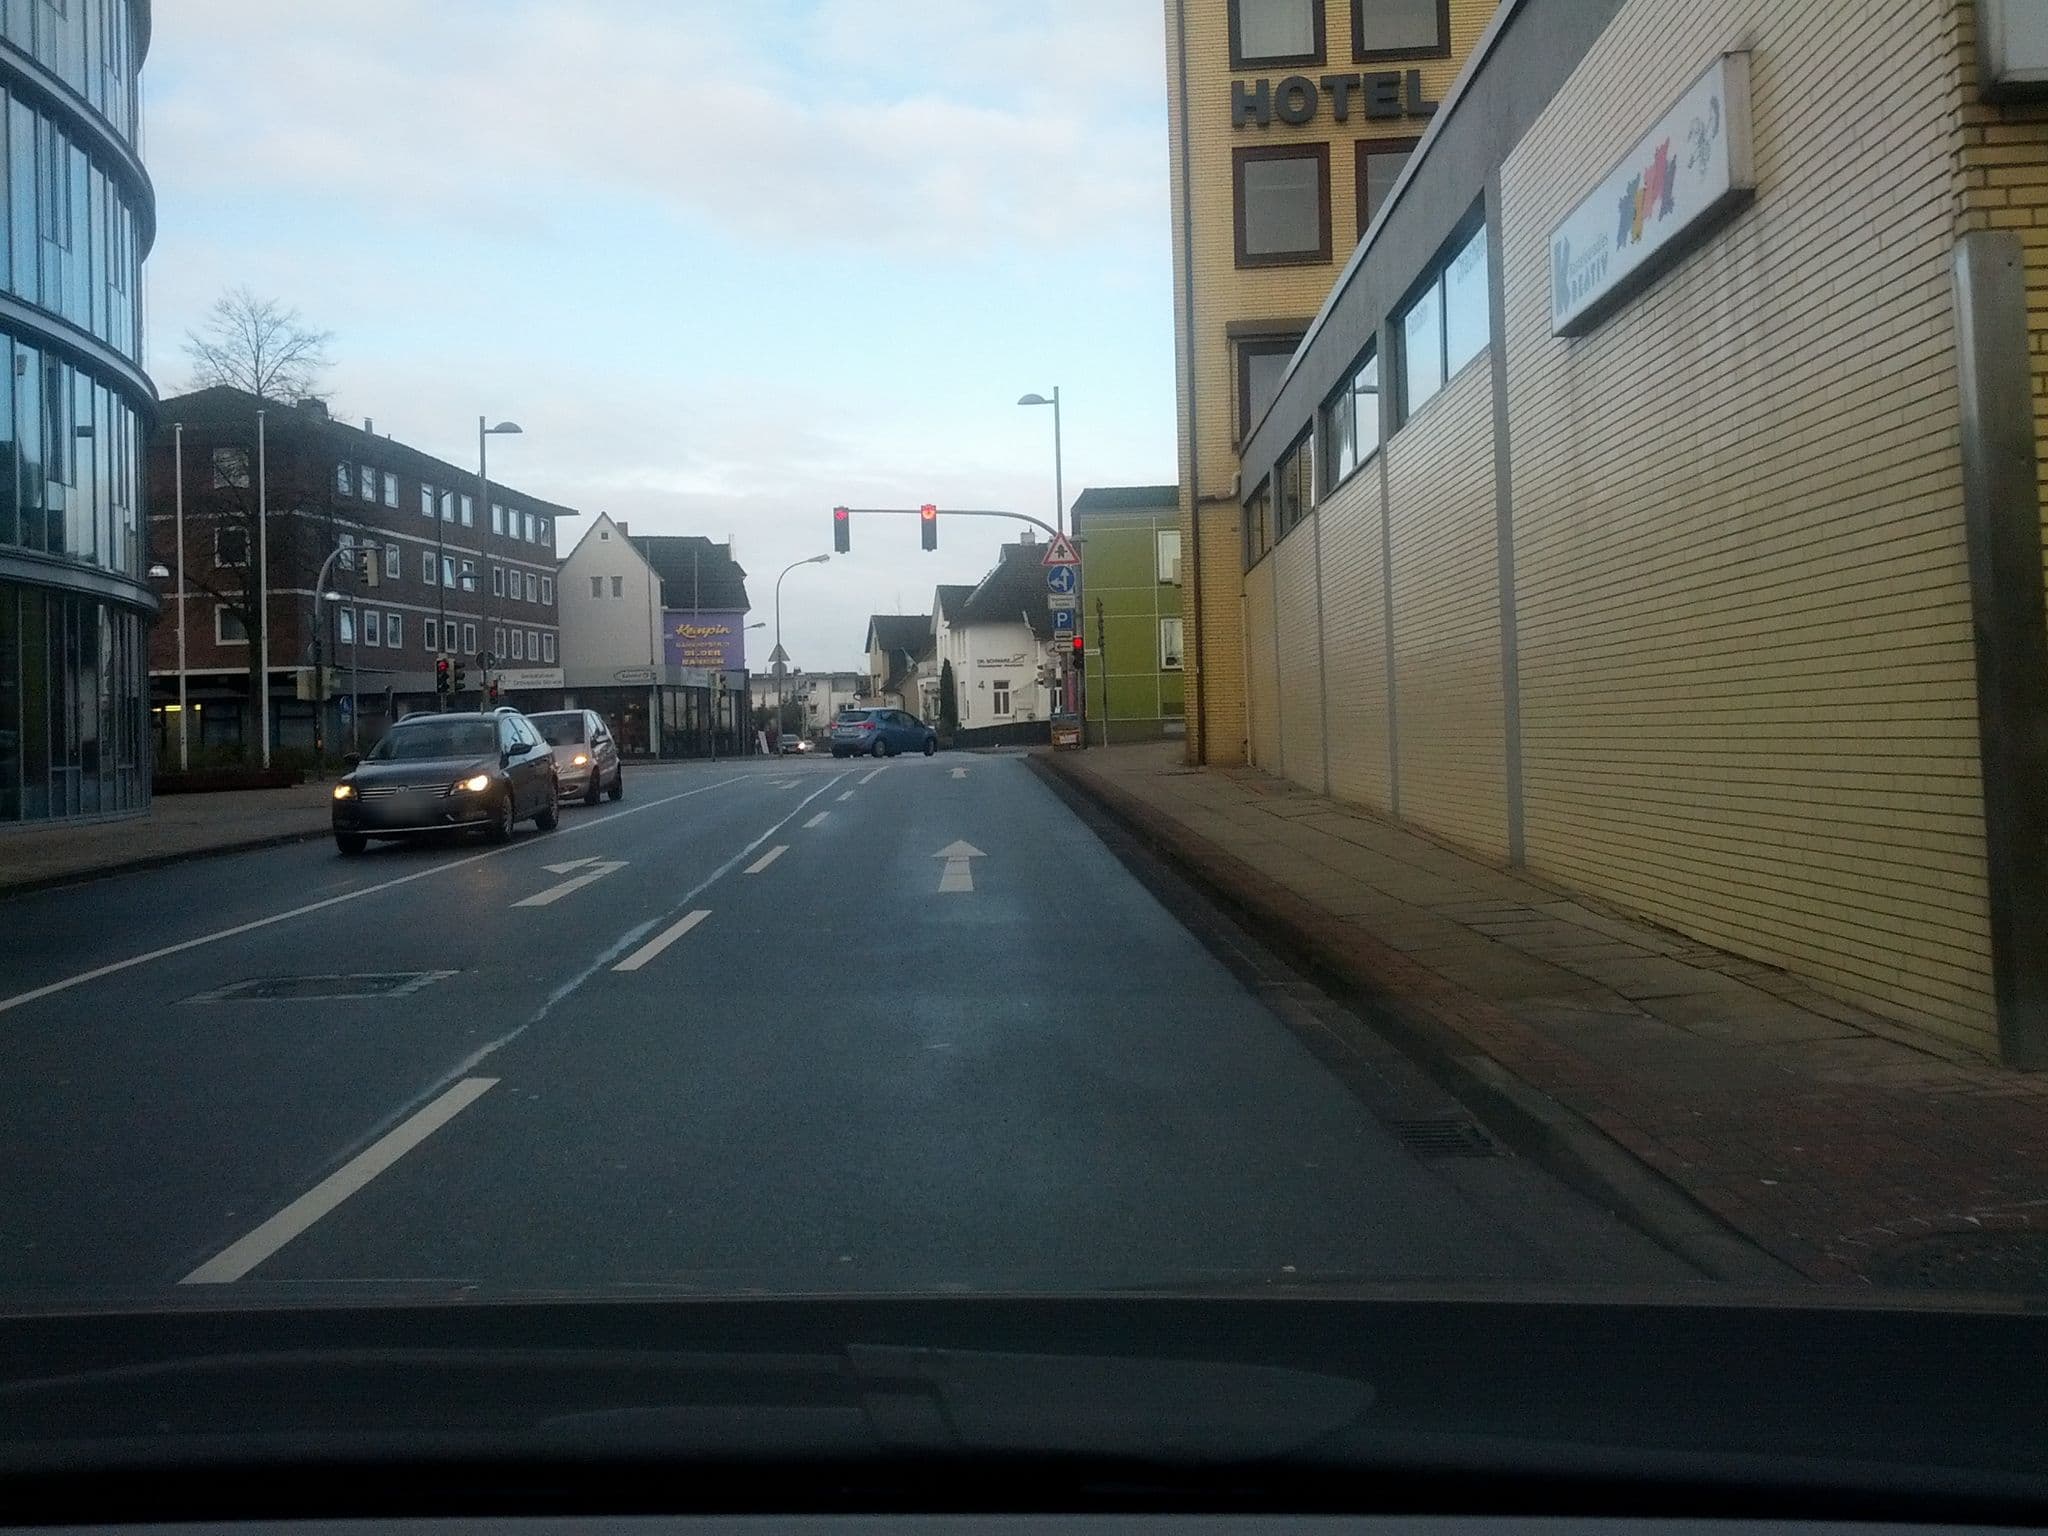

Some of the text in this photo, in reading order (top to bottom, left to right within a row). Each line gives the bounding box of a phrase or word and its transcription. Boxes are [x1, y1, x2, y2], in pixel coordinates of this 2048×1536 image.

[1231, 70, 1440, 128] HOTEL
[1057, 612, 1068, 628] P
[978, 680, 985, 691] 4
